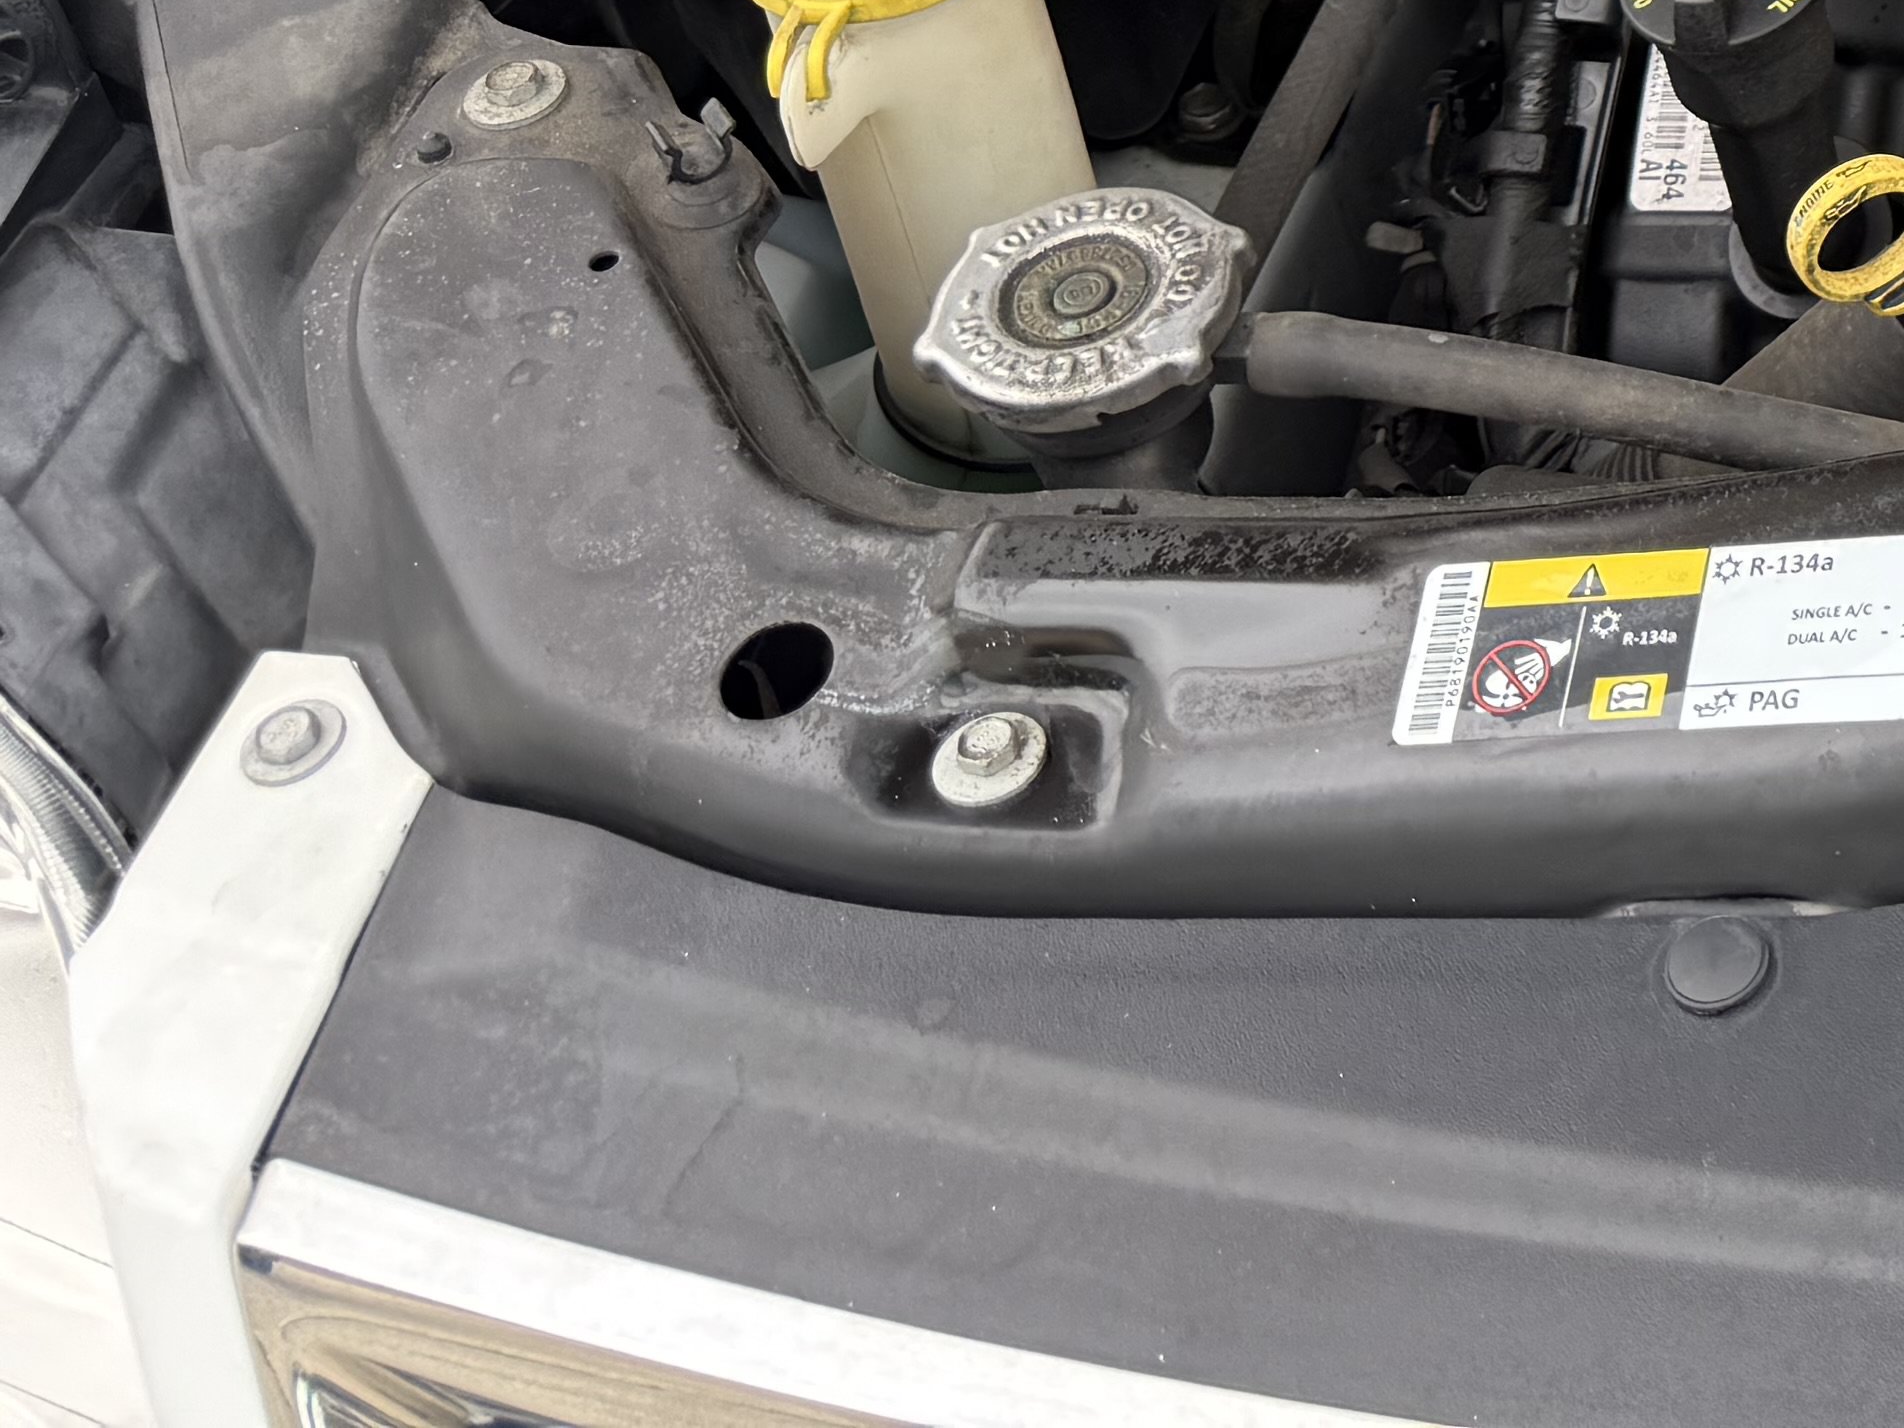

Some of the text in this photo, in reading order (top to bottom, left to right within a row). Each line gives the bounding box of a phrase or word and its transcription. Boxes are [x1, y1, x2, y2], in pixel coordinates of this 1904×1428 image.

[1662, 158, 1688, 201] 464
[1053, 199, 1151, 227] OPEN
[981, 217, 1050, 268] HOT
[1749, 553, 1835, 577] R-134a
[1791, 606, 1841, 621] SINGLE
[1845, 603, 1873, 619] A/C
[1622, 629, 1678, 646] R-134a
[1787, 631, 1826, 646] DUAL
[1829, 628, 1858, 644] A/C
[1748, 689, 1800, 712] PAG
